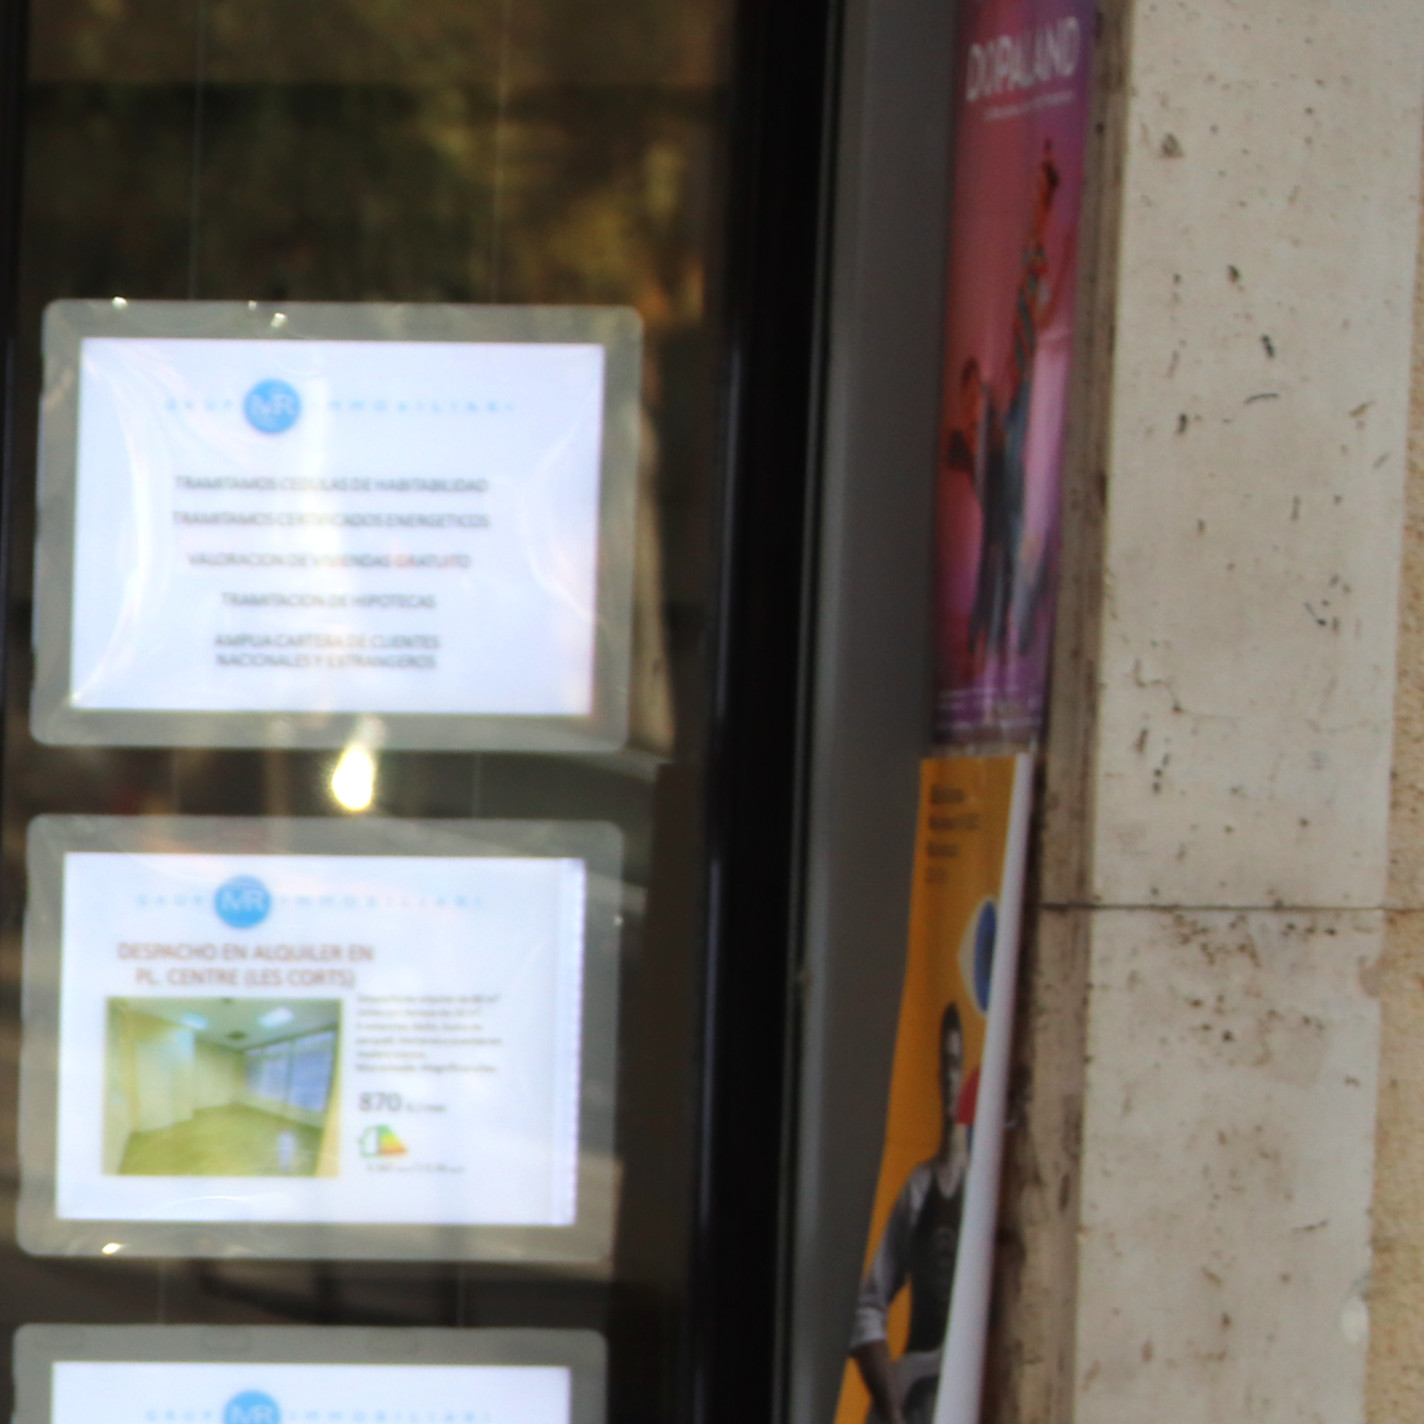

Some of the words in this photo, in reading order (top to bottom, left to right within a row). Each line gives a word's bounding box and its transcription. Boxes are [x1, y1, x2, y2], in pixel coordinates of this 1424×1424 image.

[117, 942, 216, 962] DESPACHO
[221, 943, 249, 962] EN
[252, 943, 342, 966] ALQUILER
[347, 945, 374, 963] EN
[166, 968, 240, 987] CENTRE
[287, 969, 356, 990] CORTS)
[358, 1092, 403, 1113] 870
